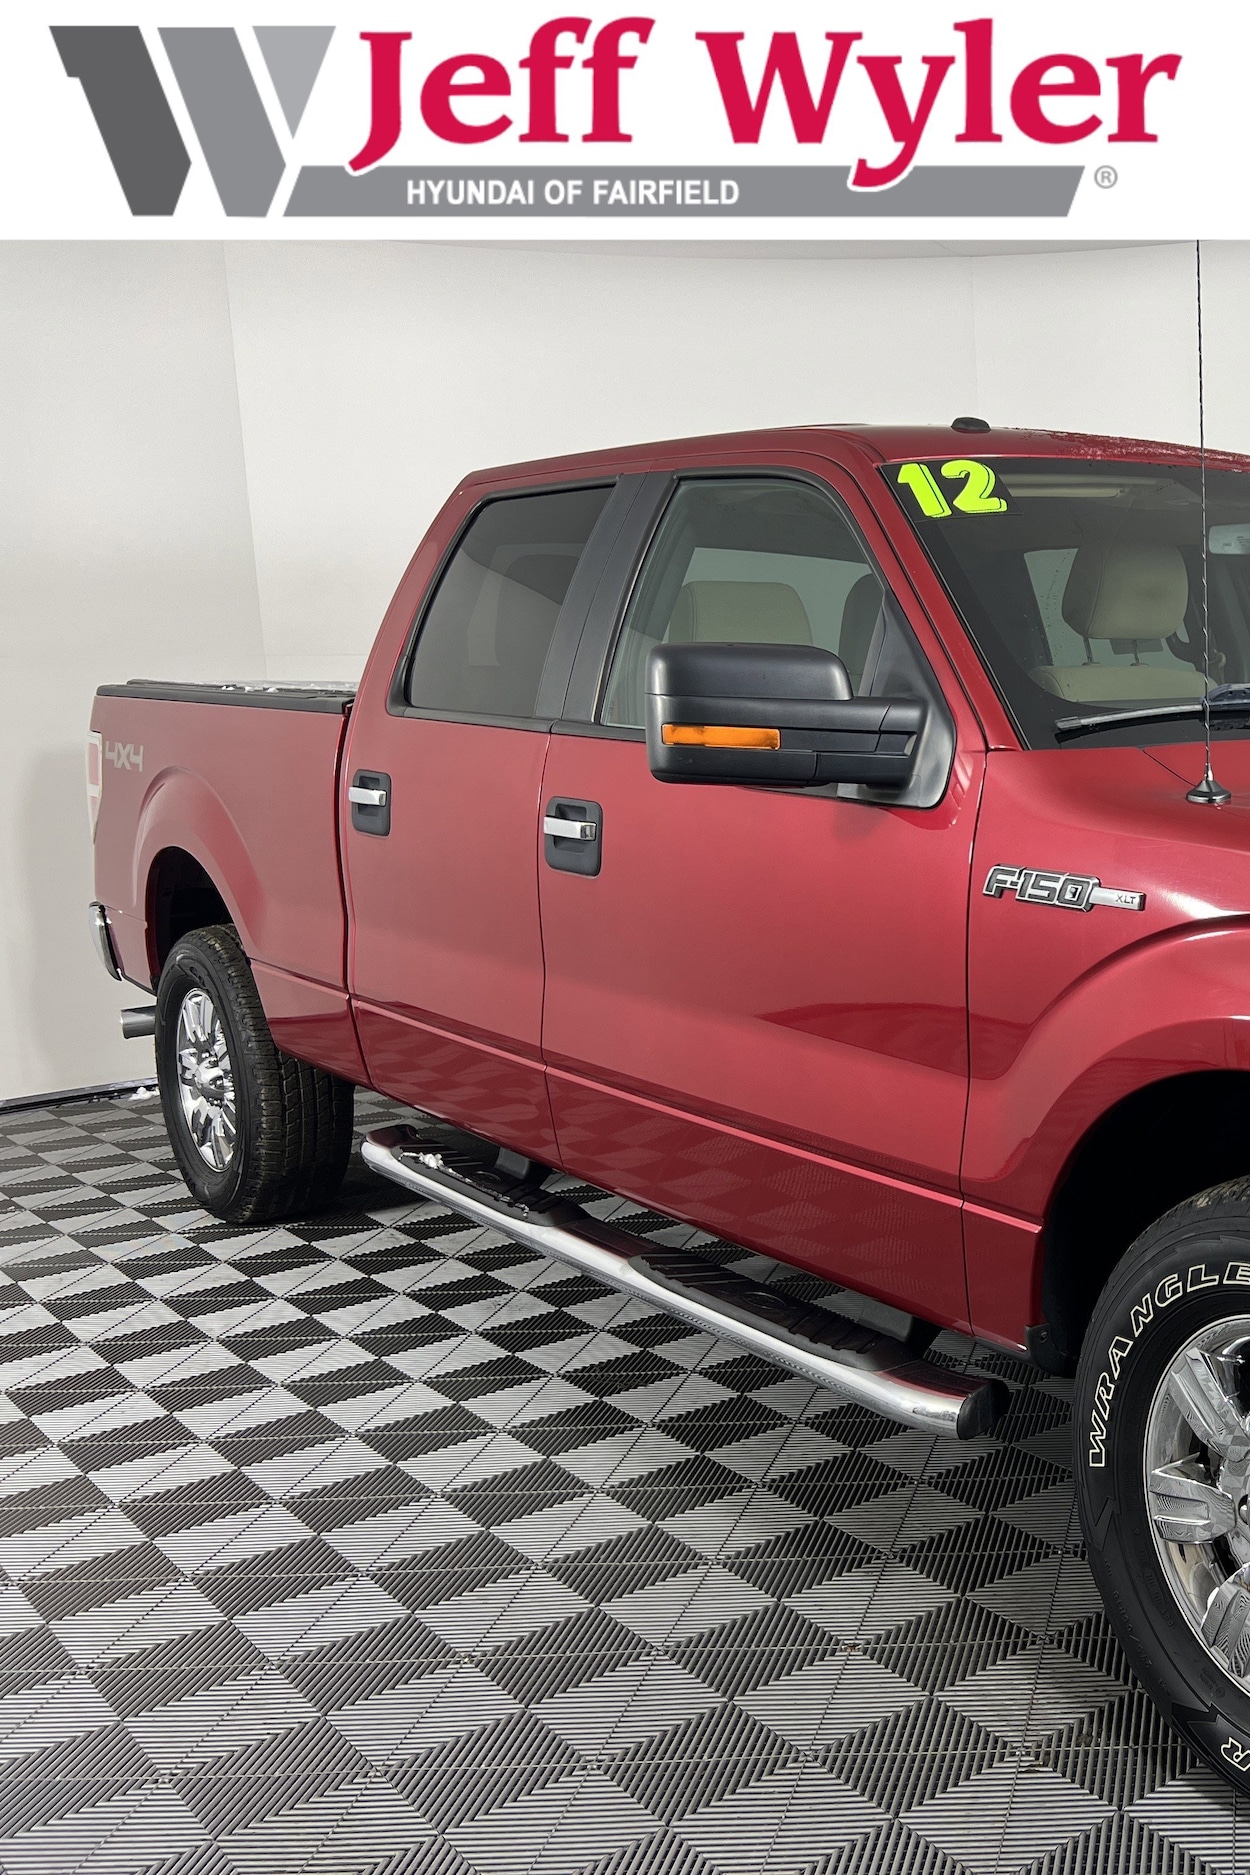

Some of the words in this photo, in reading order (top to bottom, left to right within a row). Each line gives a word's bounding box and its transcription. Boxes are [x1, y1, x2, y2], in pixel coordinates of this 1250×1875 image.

[897, 459, 1007, 518] 12
[981, 863, 1098, 912] F-150
[1114, 893, 1138, 905] XLT
